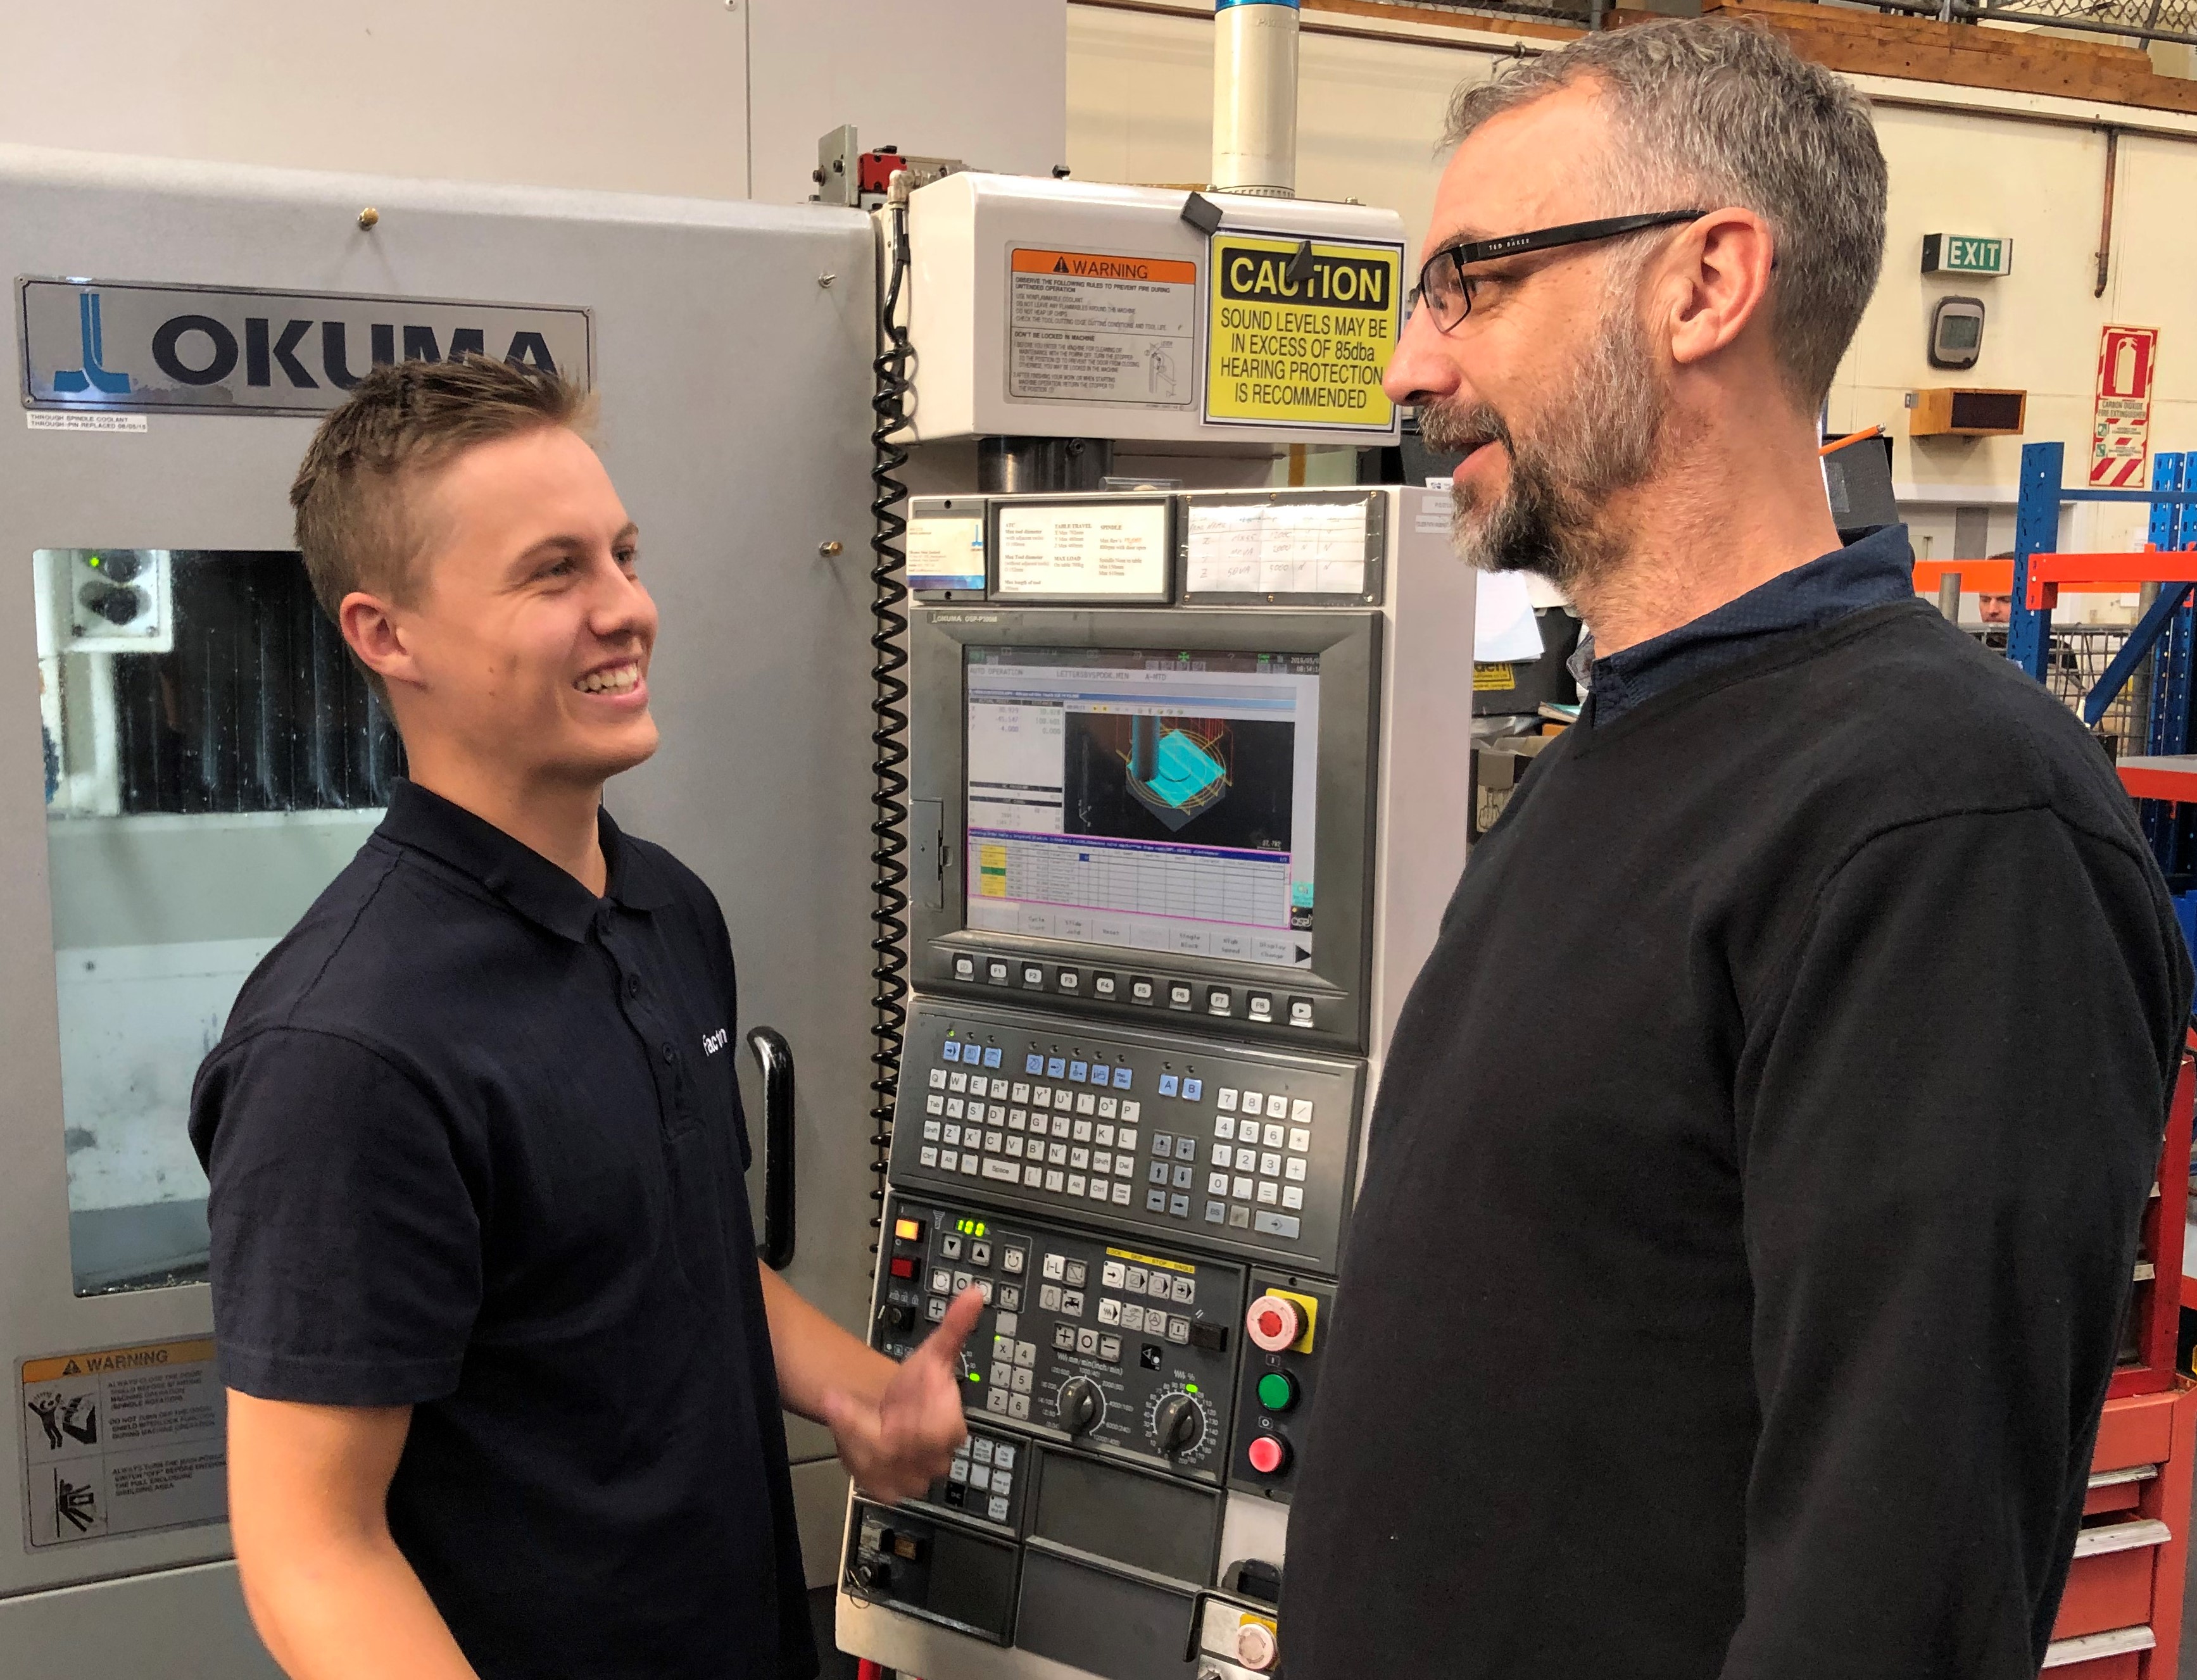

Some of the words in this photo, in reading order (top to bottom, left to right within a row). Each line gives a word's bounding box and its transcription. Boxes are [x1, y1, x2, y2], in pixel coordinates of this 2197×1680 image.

[1950, 241, 1999, 267] EXIT
[1073, 260, 1147, 279] WARNING
[1221, 307, 1271, 330] SOUND
[1276, 311, 1330, 335] LEVELS
[1335, 317, 1365, 336] MAY
[1368, 318, 1387, 338] BE
[152, 315, 557, 390] OKUMA
[1231, 333, 1245, 353] IN
[1250, 334, 1307, 357] EXCESS
[1311, 338, 1331, 358] OF
[1335, 341, 1375, 361] 85dba
[1221, 357, 1285, 380] HEARING
[1290, 361, 1383, 386] PROTECTION
[1235, 382, 1247, 403] IS
[1252, 385, 1367, 408] RECOMMENDED
[1164, 1081, 1171, 1089] A
[1188, 1084, 1195, 1093] B
[1016, 1088, 1021, 1096] T
[1101, 1102, 1108, 1111] O
[1224, 1094, 1231, 1103] 7
[1249, 1098, 1255, 1107] 8
[1274, 1102, 1280, 1111] 9
[1033, 1118, 1040, 1126] G
[1077, 1126, 1083, 1134] J
[1098, 1130, 1105, 1138] K
[1221, 1123, 1228, 1131] 4
[1245, 1127, 1252, 1136] 5
[1270, 1131, 1277, 1139] 6
[1029, 1144, 1036, 1153] B
[1073, 1153, 1081, 1162] M
[1094, 1157, 1109, 1165] Shift
[1242, 1155, 1249, 1164] 2
[1267, 1160, 1274, 1169] 3
[991, 1165, 1009, 1174] Space
[1214, 1179, 1221, 1188] 0
[1174, 1263, 1193, 1272] SINGLE
[86, 1350, 168, 1372] WARNING
[1000, 1345, 1007, 1353] X
[1021, 1350, 1027, 1358] 4
[997, 1370, 1003, 1379] Y
[1019, 1376, 1024, 1384] 5
[994, 1396, 1000, 1405] Z
[1016, 1401, 1021, 1411] 6
